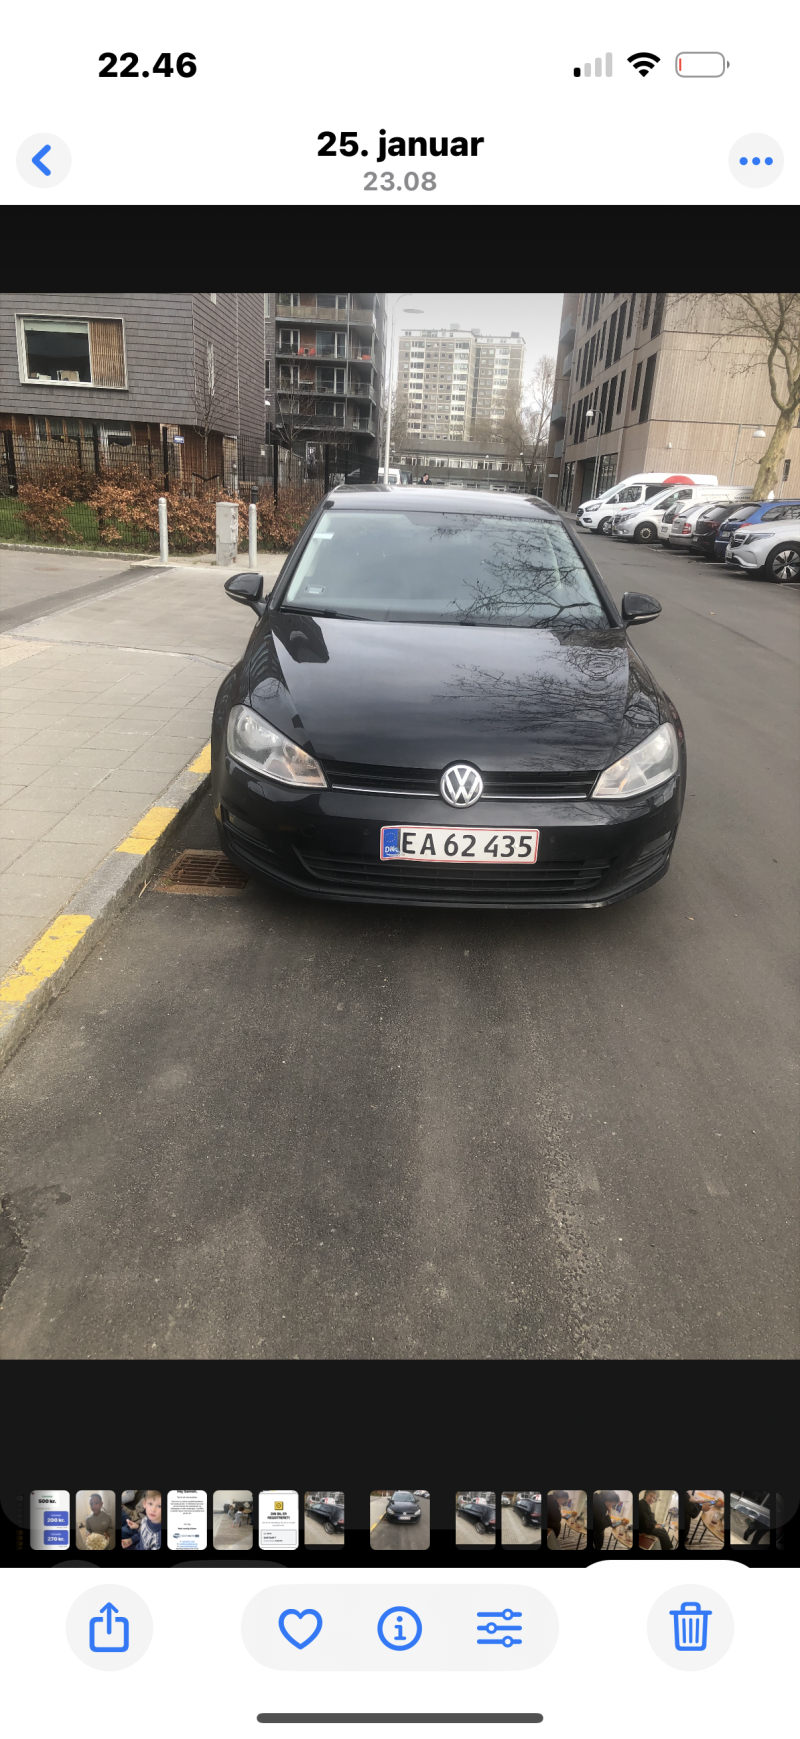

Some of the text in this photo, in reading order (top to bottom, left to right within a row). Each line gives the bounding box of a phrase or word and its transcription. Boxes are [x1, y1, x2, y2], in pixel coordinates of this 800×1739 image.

[402, 832, 533, 858] EA 62 435
